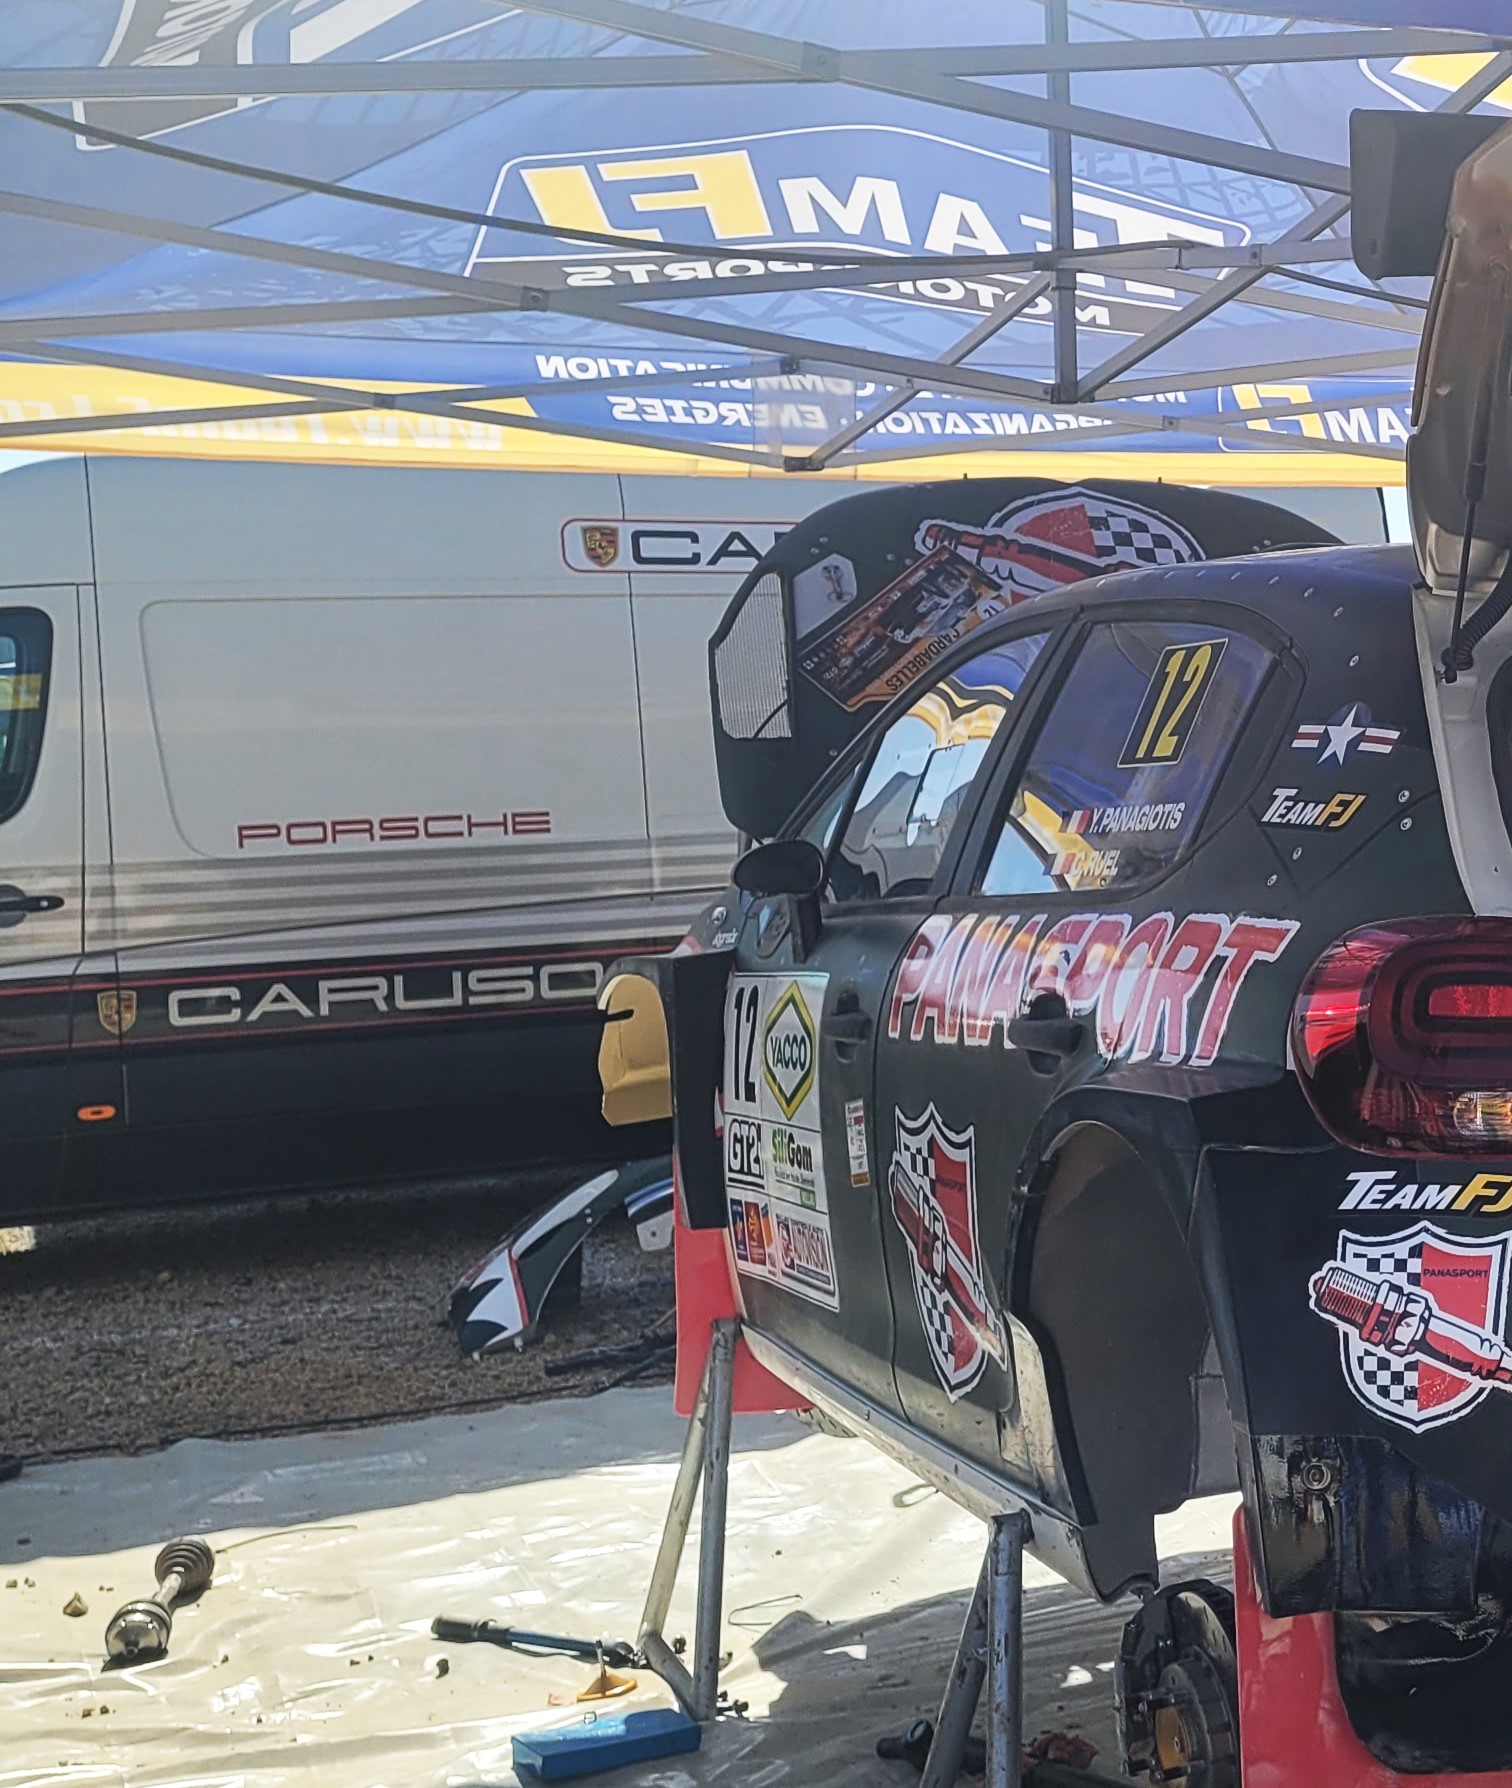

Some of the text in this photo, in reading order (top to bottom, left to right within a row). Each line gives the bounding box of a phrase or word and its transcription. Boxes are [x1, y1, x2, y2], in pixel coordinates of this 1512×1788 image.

[1135, 644, 1212, 759] 12
[237, 811, 551, 849] PORSCHE
[168, 962, 604, 1027] CARUSO
[888, 912, 1301, 1068] PANASPORT
[734, 985, 759, 1103] 12
[770, 1033, 808, 1072] YACCO
[1423, 1268, 1489, 1278] PANASPORT
